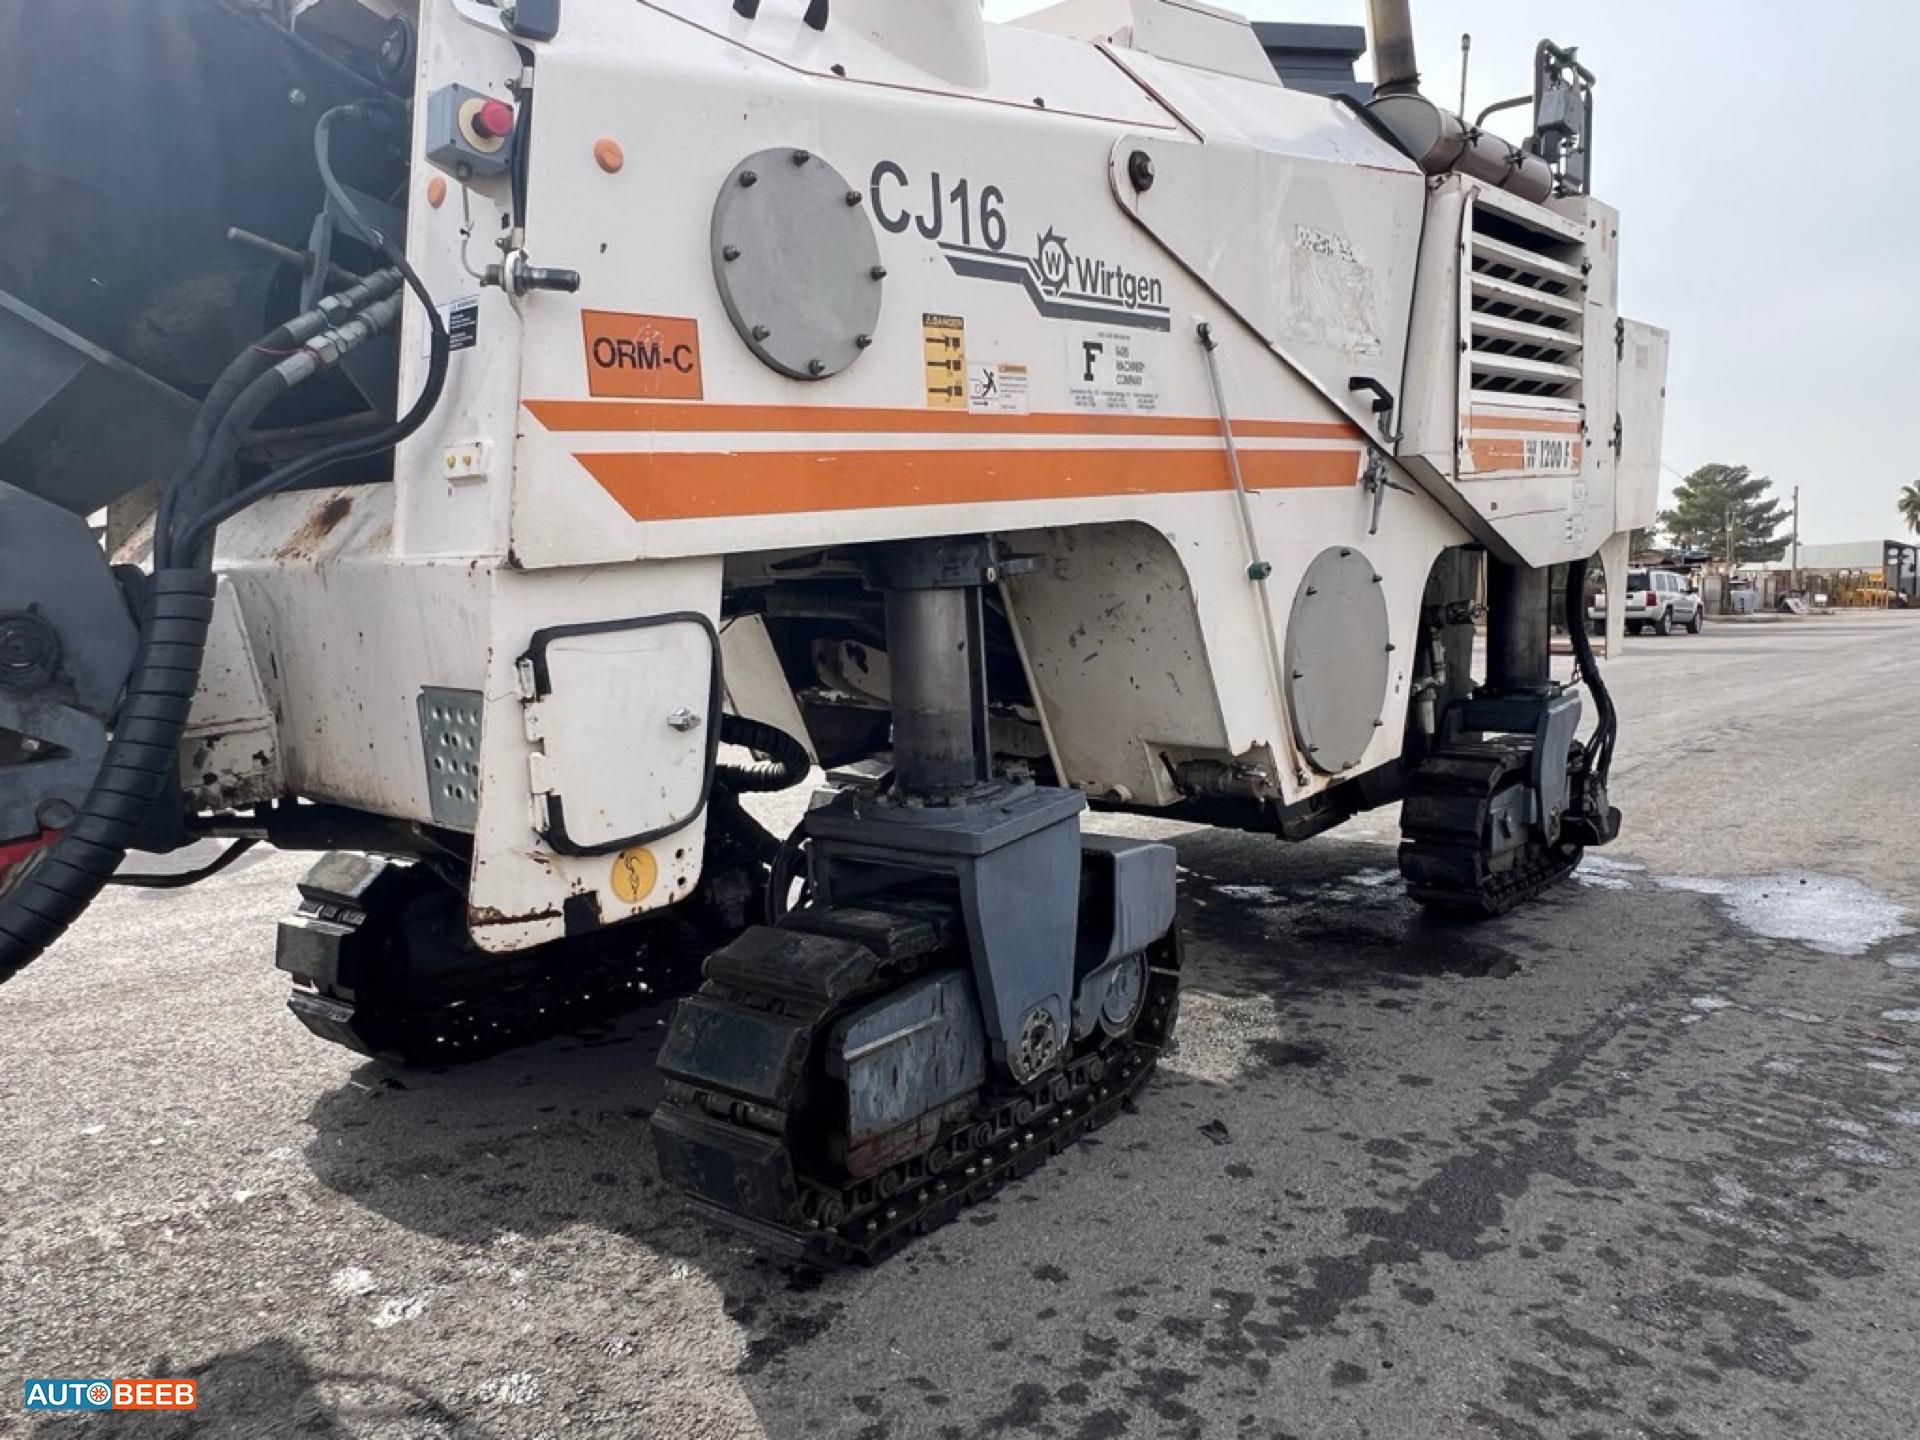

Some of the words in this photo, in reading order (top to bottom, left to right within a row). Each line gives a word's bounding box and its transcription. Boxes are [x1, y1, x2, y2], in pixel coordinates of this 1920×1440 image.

[870, 160, 1006, 250] CJ16
[1044, 250, 1062, 276] W
[1076, 254, 1162, 309] Wirtgen
[592, 336, 694, 374] ORM-C
[1082, 340, 1104, 382] F
